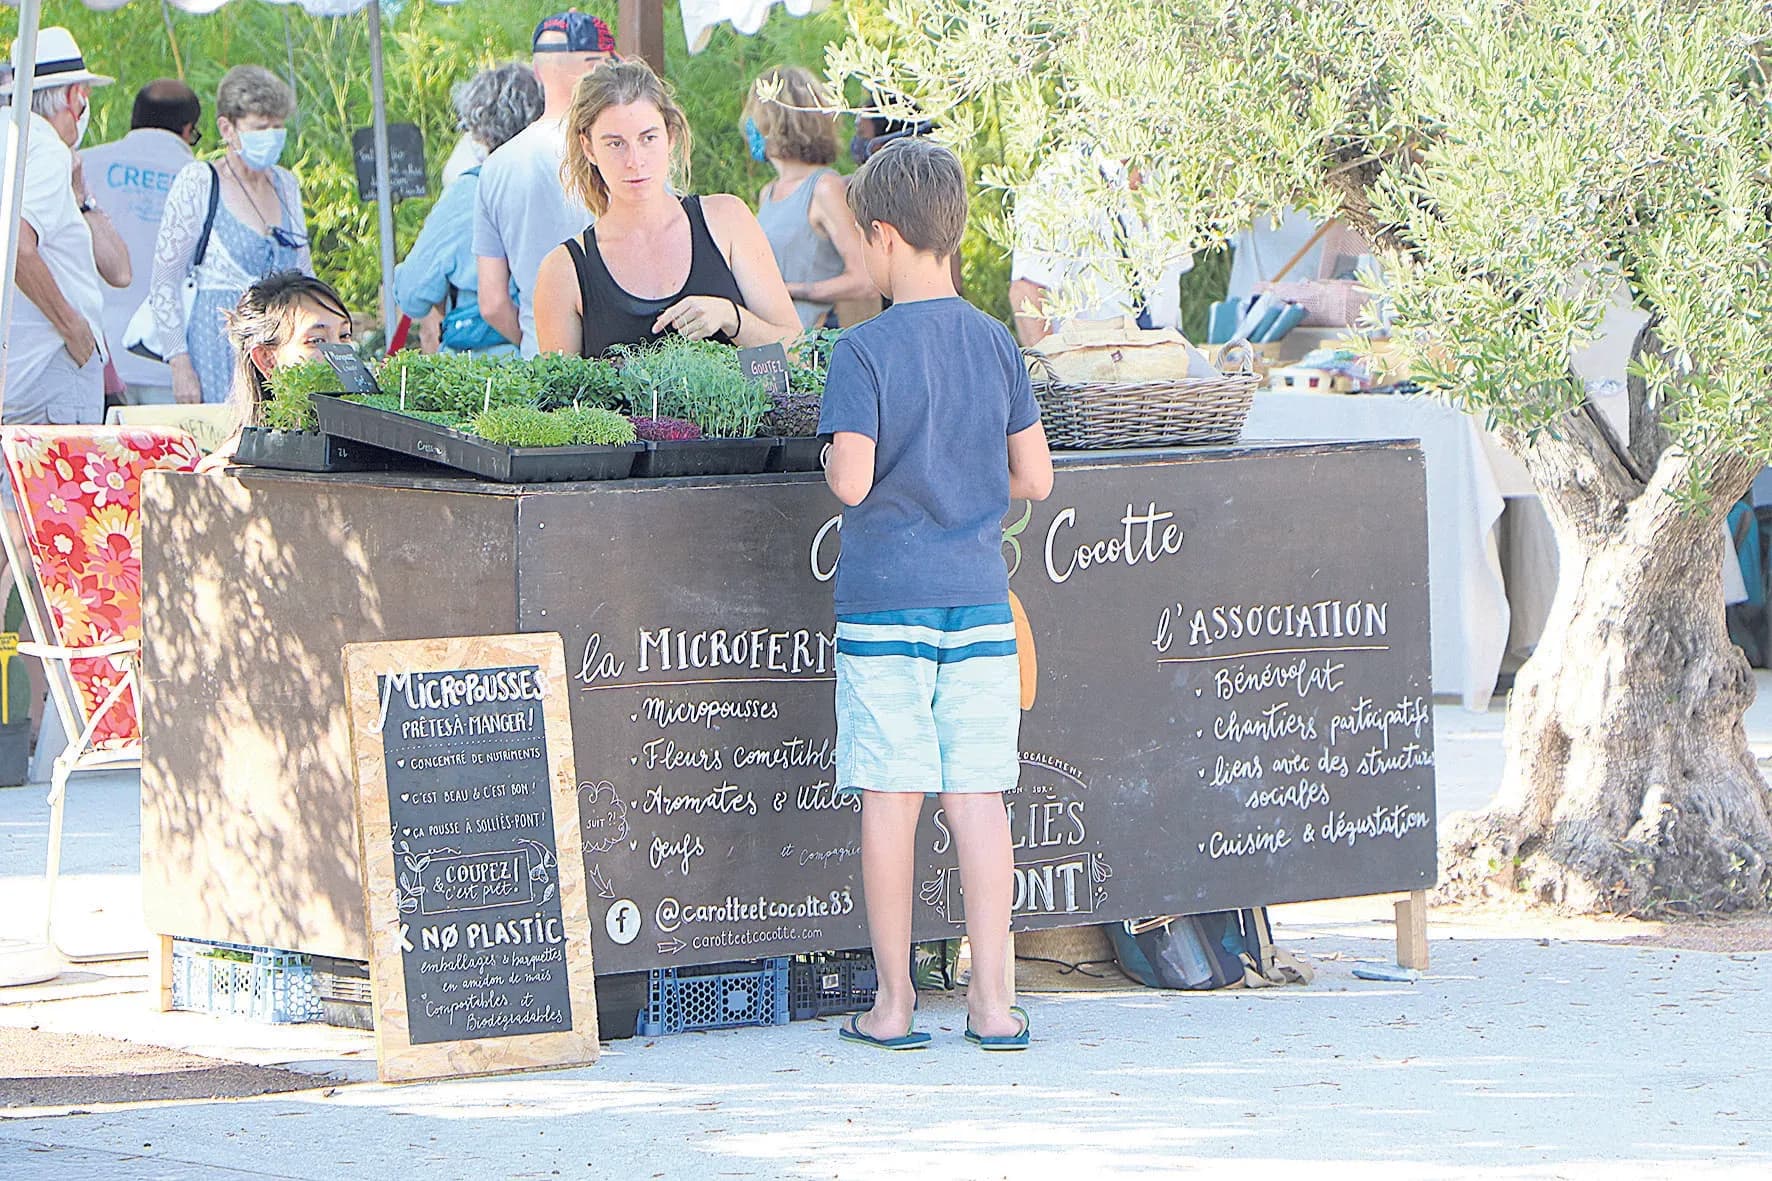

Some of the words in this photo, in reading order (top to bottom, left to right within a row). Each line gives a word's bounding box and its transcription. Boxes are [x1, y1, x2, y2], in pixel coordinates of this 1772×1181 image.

[107, 162, 176, 192] CREE
[751, 360, 784, 375] GOUTEZ
[1044, 501, 1184, 584] Cocotte
[575, 633, 625, 684] la
[637, 626, 837, 673] MICROFERM
[1215, 658, 1344, 700] Bénévolat
[1331, 695, 1430, 749] participatifs
[411, 751, 466, 770] CONCENTRÉ
[471, 753, 484, 764] DE
[487, 748, 541, 763] NUTRIMENTS
[642, 738, 723, 771] Fleurs
[1017, 751, 1083, 778] LOCALEMENT
[1273, 755, 1310, 775] avec
[1318, 746, 1349, 777] des
[412, 792, 437, 804] C'EST
[444, 789, 468, 801] BEAU
[473, 787, 480, 800] &
[483, 784, 507, 798] C'EST
[642, 780, 757, 816] Aromates
[773, 791, 788, 812] &
[1245, 778, 1330, 809] sociales
[413, 827, 425, 840] ÇA
[428, 822, 460, 836] POUSSE
[1210, 826, 1292, 859] Cuisine
[1303, 823, 1315, 843] &
[1321, 804, 1430, 847] dégustation
[781, 843, 795, 857] et
[433, 876, 445, 893] &
[1011, 861, 1084, 912] ONT
[692, 926, 823, 949] carotteetcocotte.com
[421, 953, 496, 975] emballages
[512, 947, 562, 971] barquettes
[443, 982, 457, 992] en
[462, 972, 504, 989] amidon
[509, 971, 521, 984] de
[426, 990, 508, 1025] Compostables
[520, 992, 534, 1007] et
[466, 1004, 562, 1031] Biodégradables
